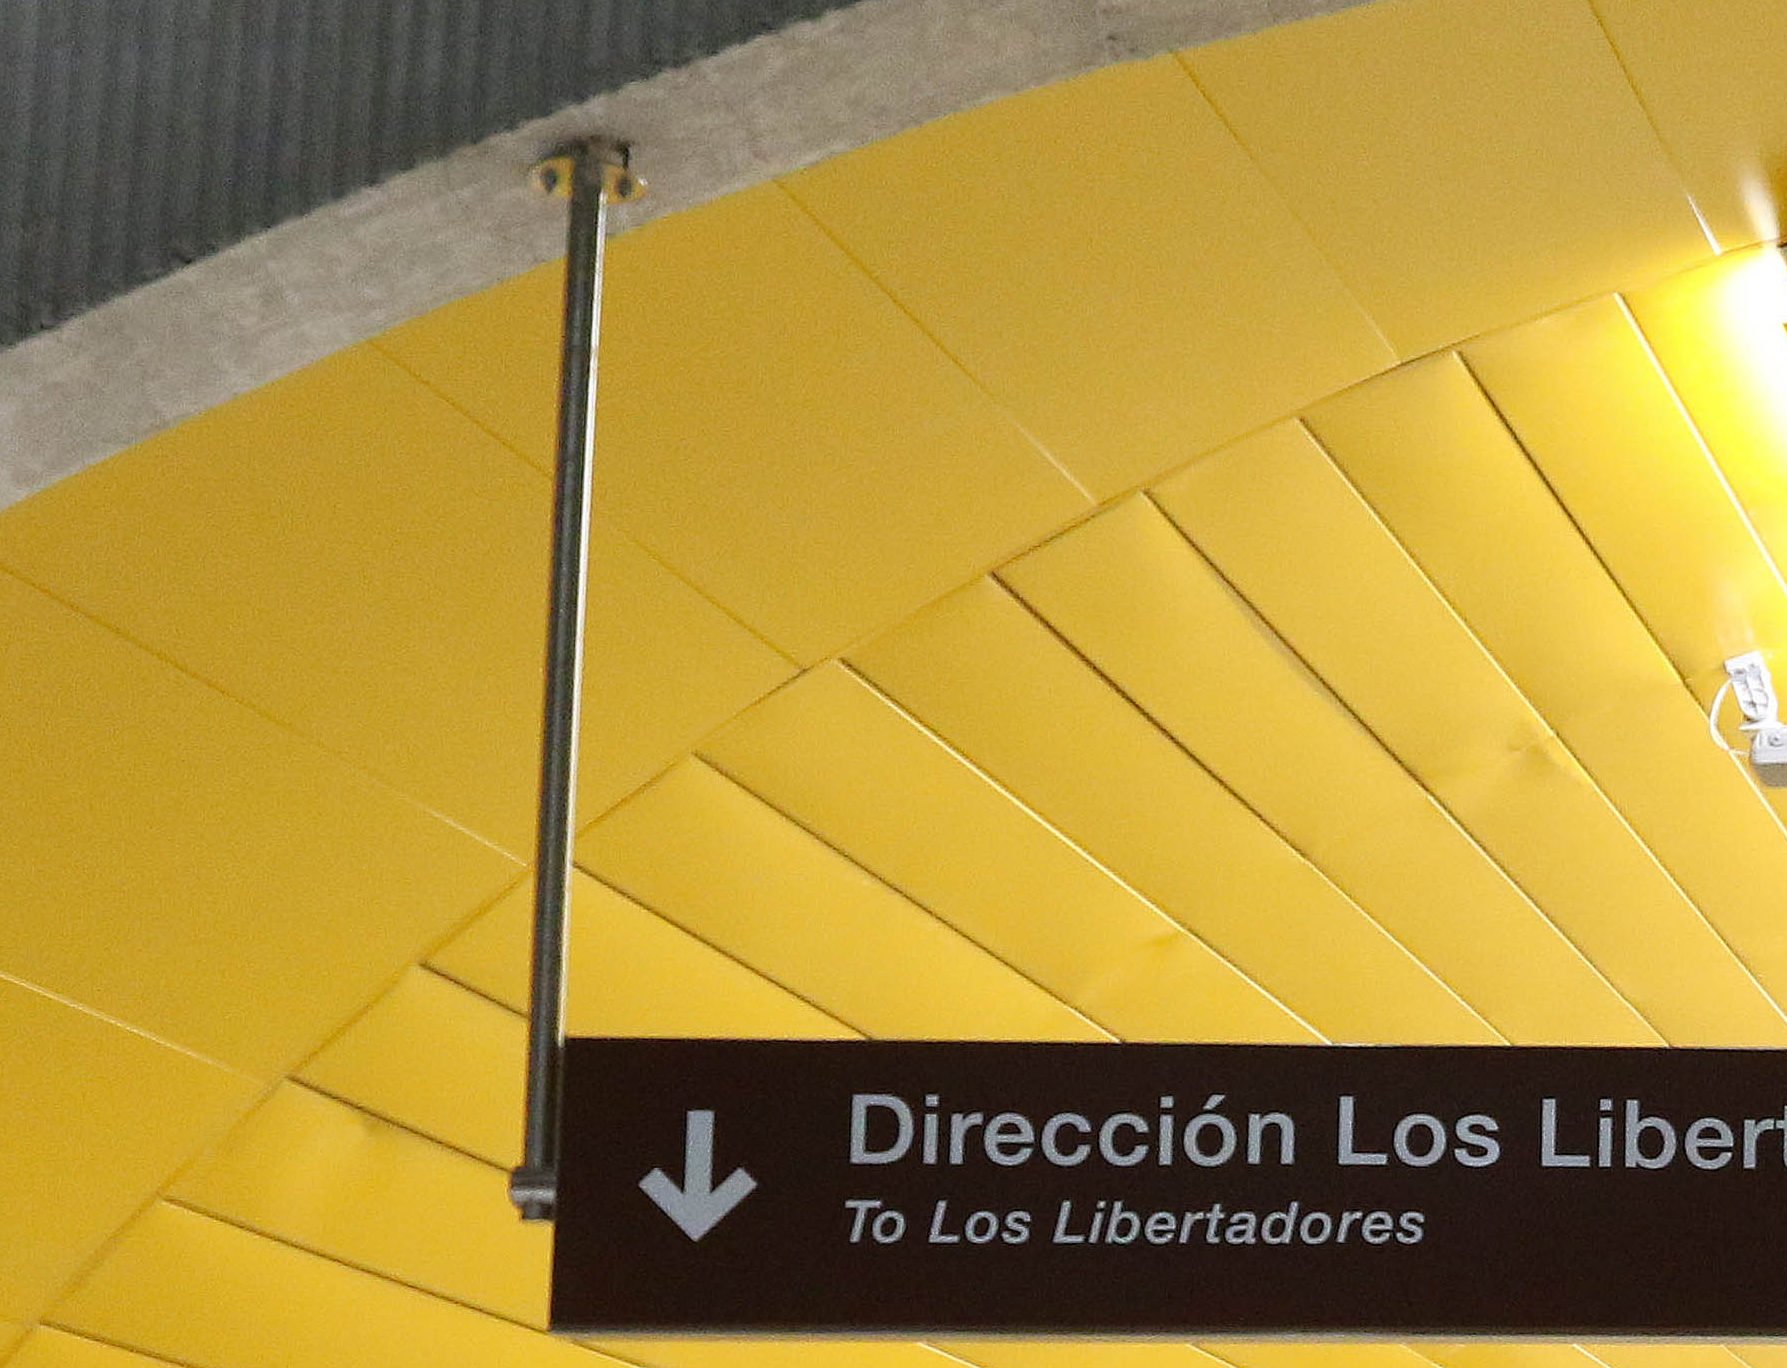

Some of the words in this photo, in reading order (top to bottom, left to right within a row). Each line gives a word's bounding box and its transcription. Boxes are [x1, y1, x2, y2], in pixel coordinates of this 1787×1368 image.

[850, 1094, 1295, 1167] Dirección
[1337, 1095, 1501, 1168] Los
[846, 1200, 906, 1244] To
[928, 1200, 1031, 1244] Los
[1052, 1200, 1425, 1245] Libertadores
